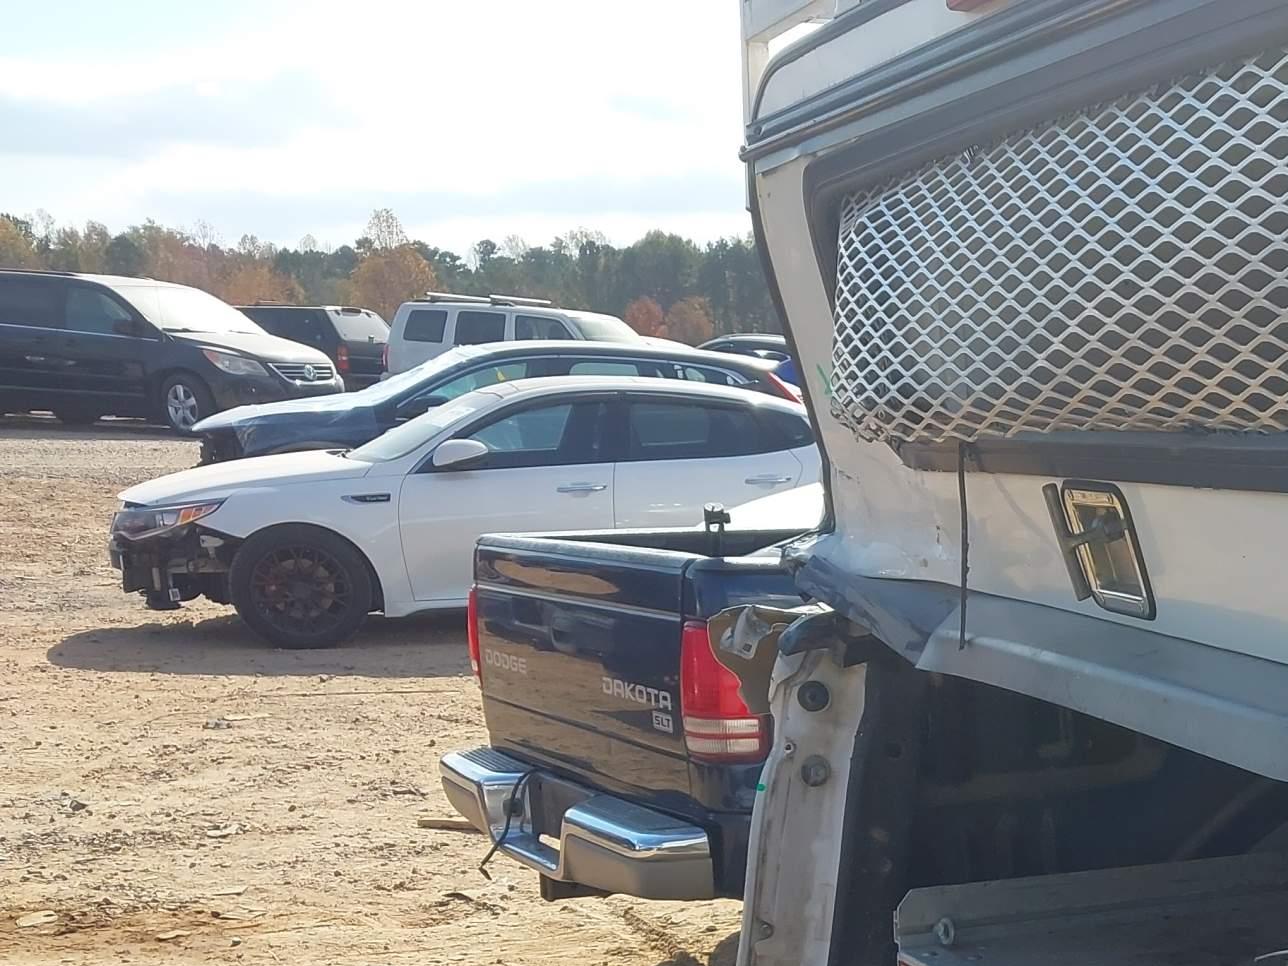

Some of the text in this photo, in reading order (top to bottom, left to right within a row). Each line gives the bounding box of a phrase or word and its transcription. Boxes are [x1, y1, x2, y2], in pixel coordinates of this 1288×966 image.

[485, 648, 527, 674] DODGE
[602, 676, 672, 711] DAKOTA
[654, 715, 671, 729] SLT
